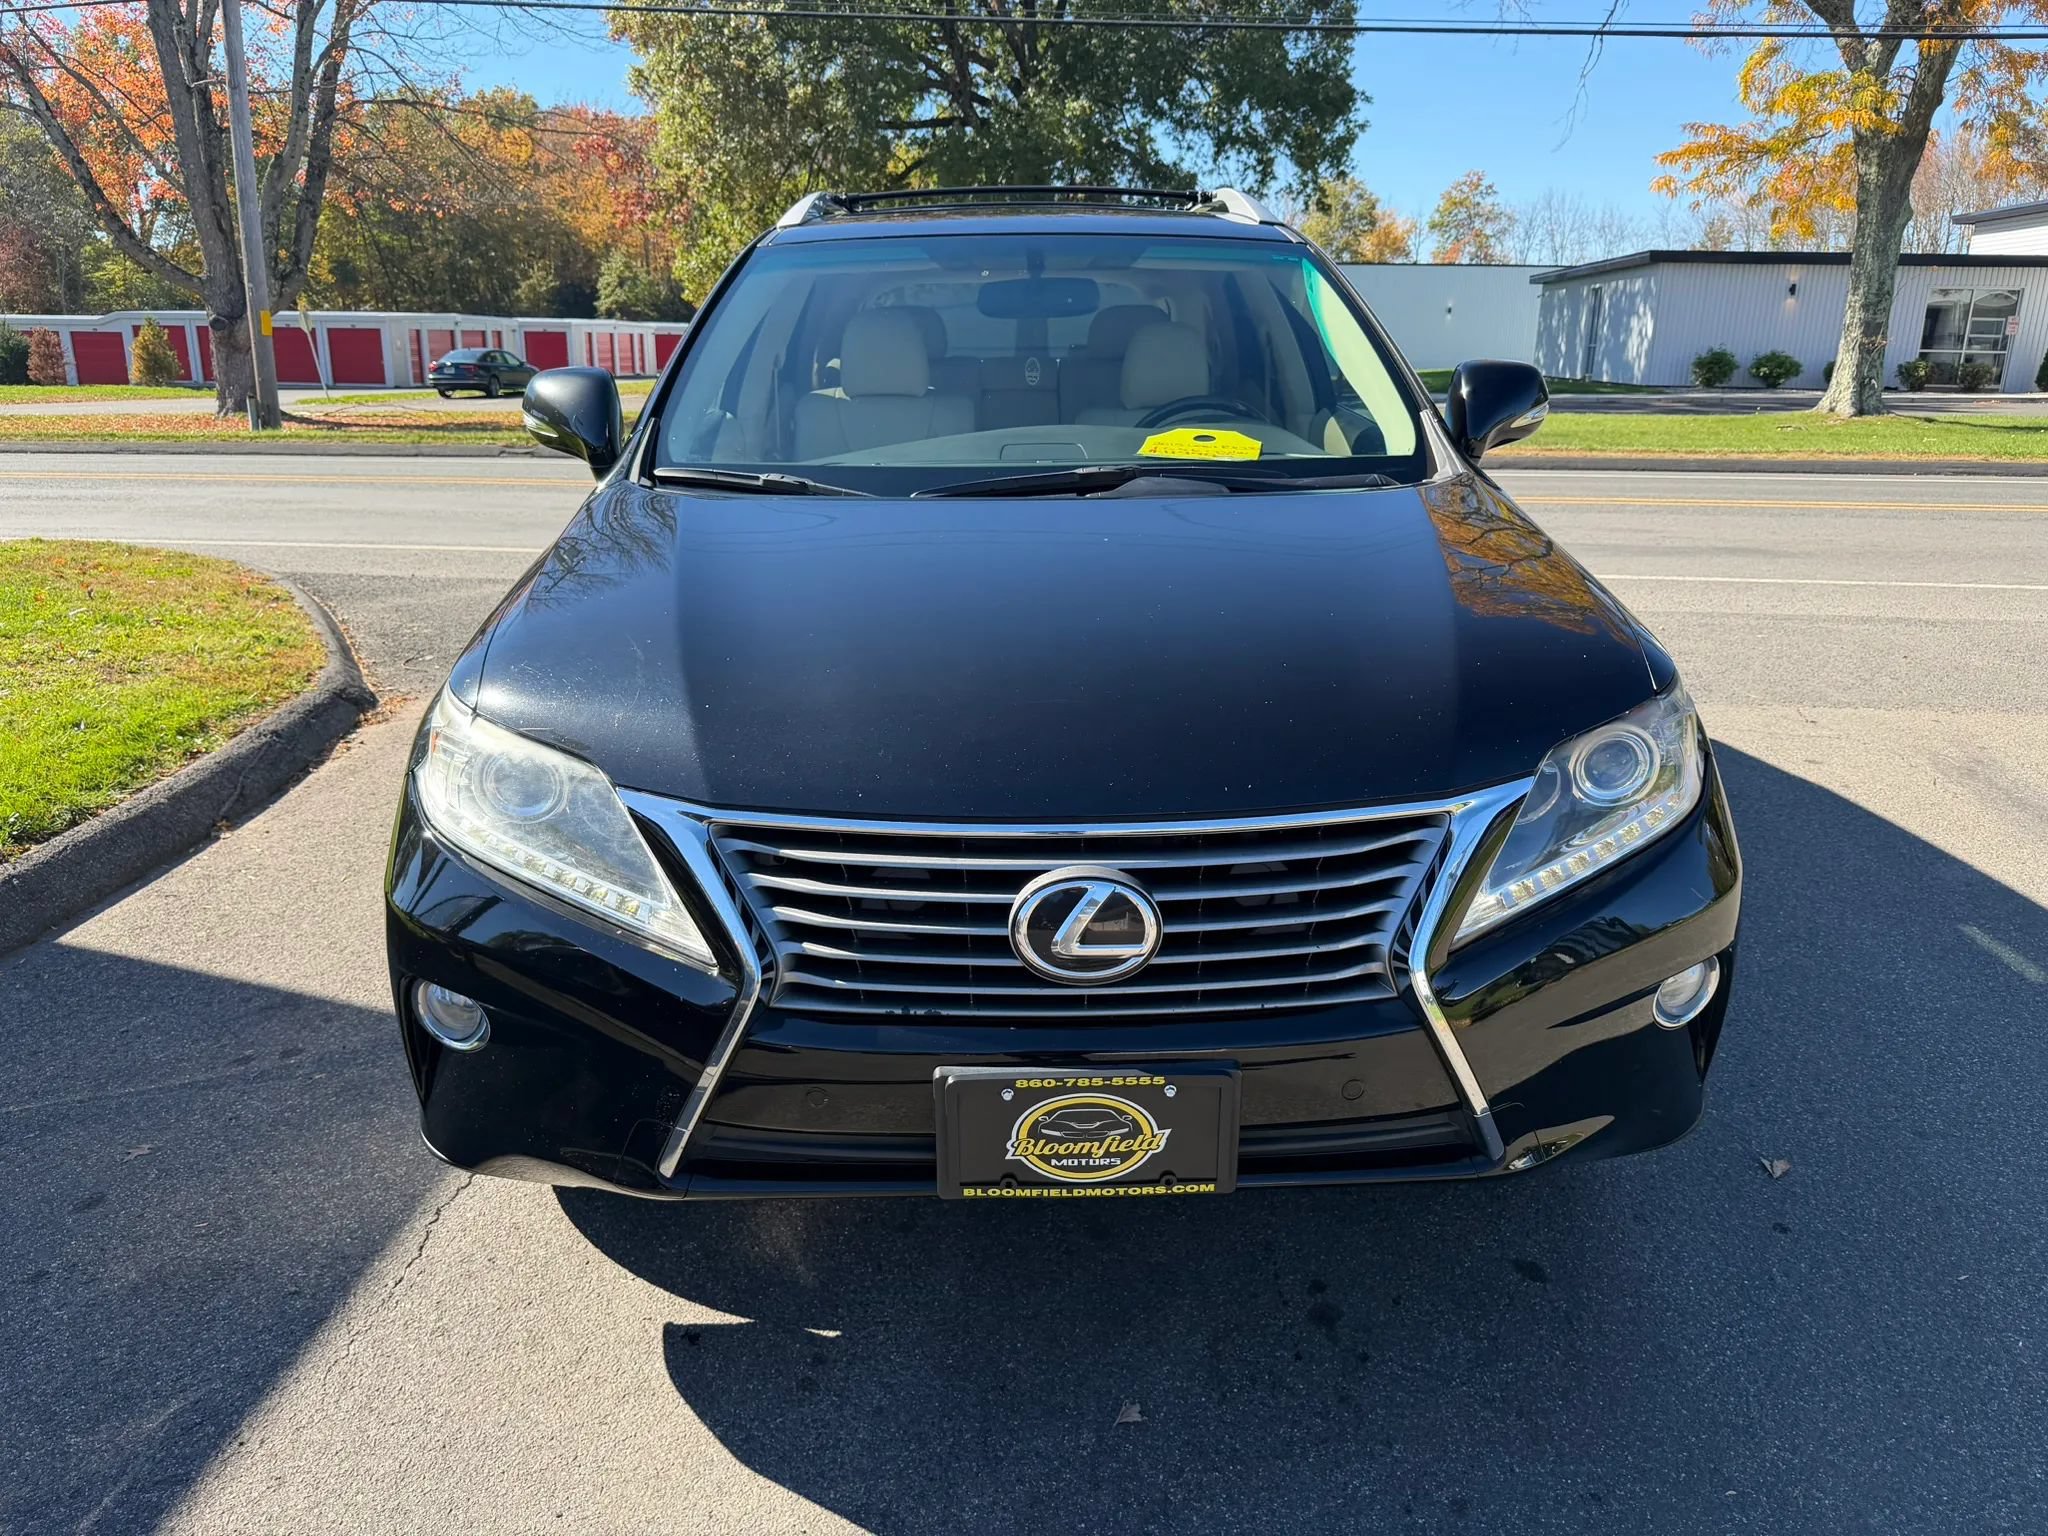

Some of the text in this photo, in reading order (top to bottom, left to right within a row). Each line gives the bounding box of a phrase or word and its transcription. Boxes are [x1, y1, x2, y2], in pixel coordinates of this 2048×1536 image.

[1015, 1076, 1165, 1089] 860-785-5555
[1013, 1133, 1163, 1158] Bloomfield
[1051, 1157, 1121, 1166] MOTORS
[963, 1184, 1215, 1197] BLOOMFIELDMOTORS.COM
